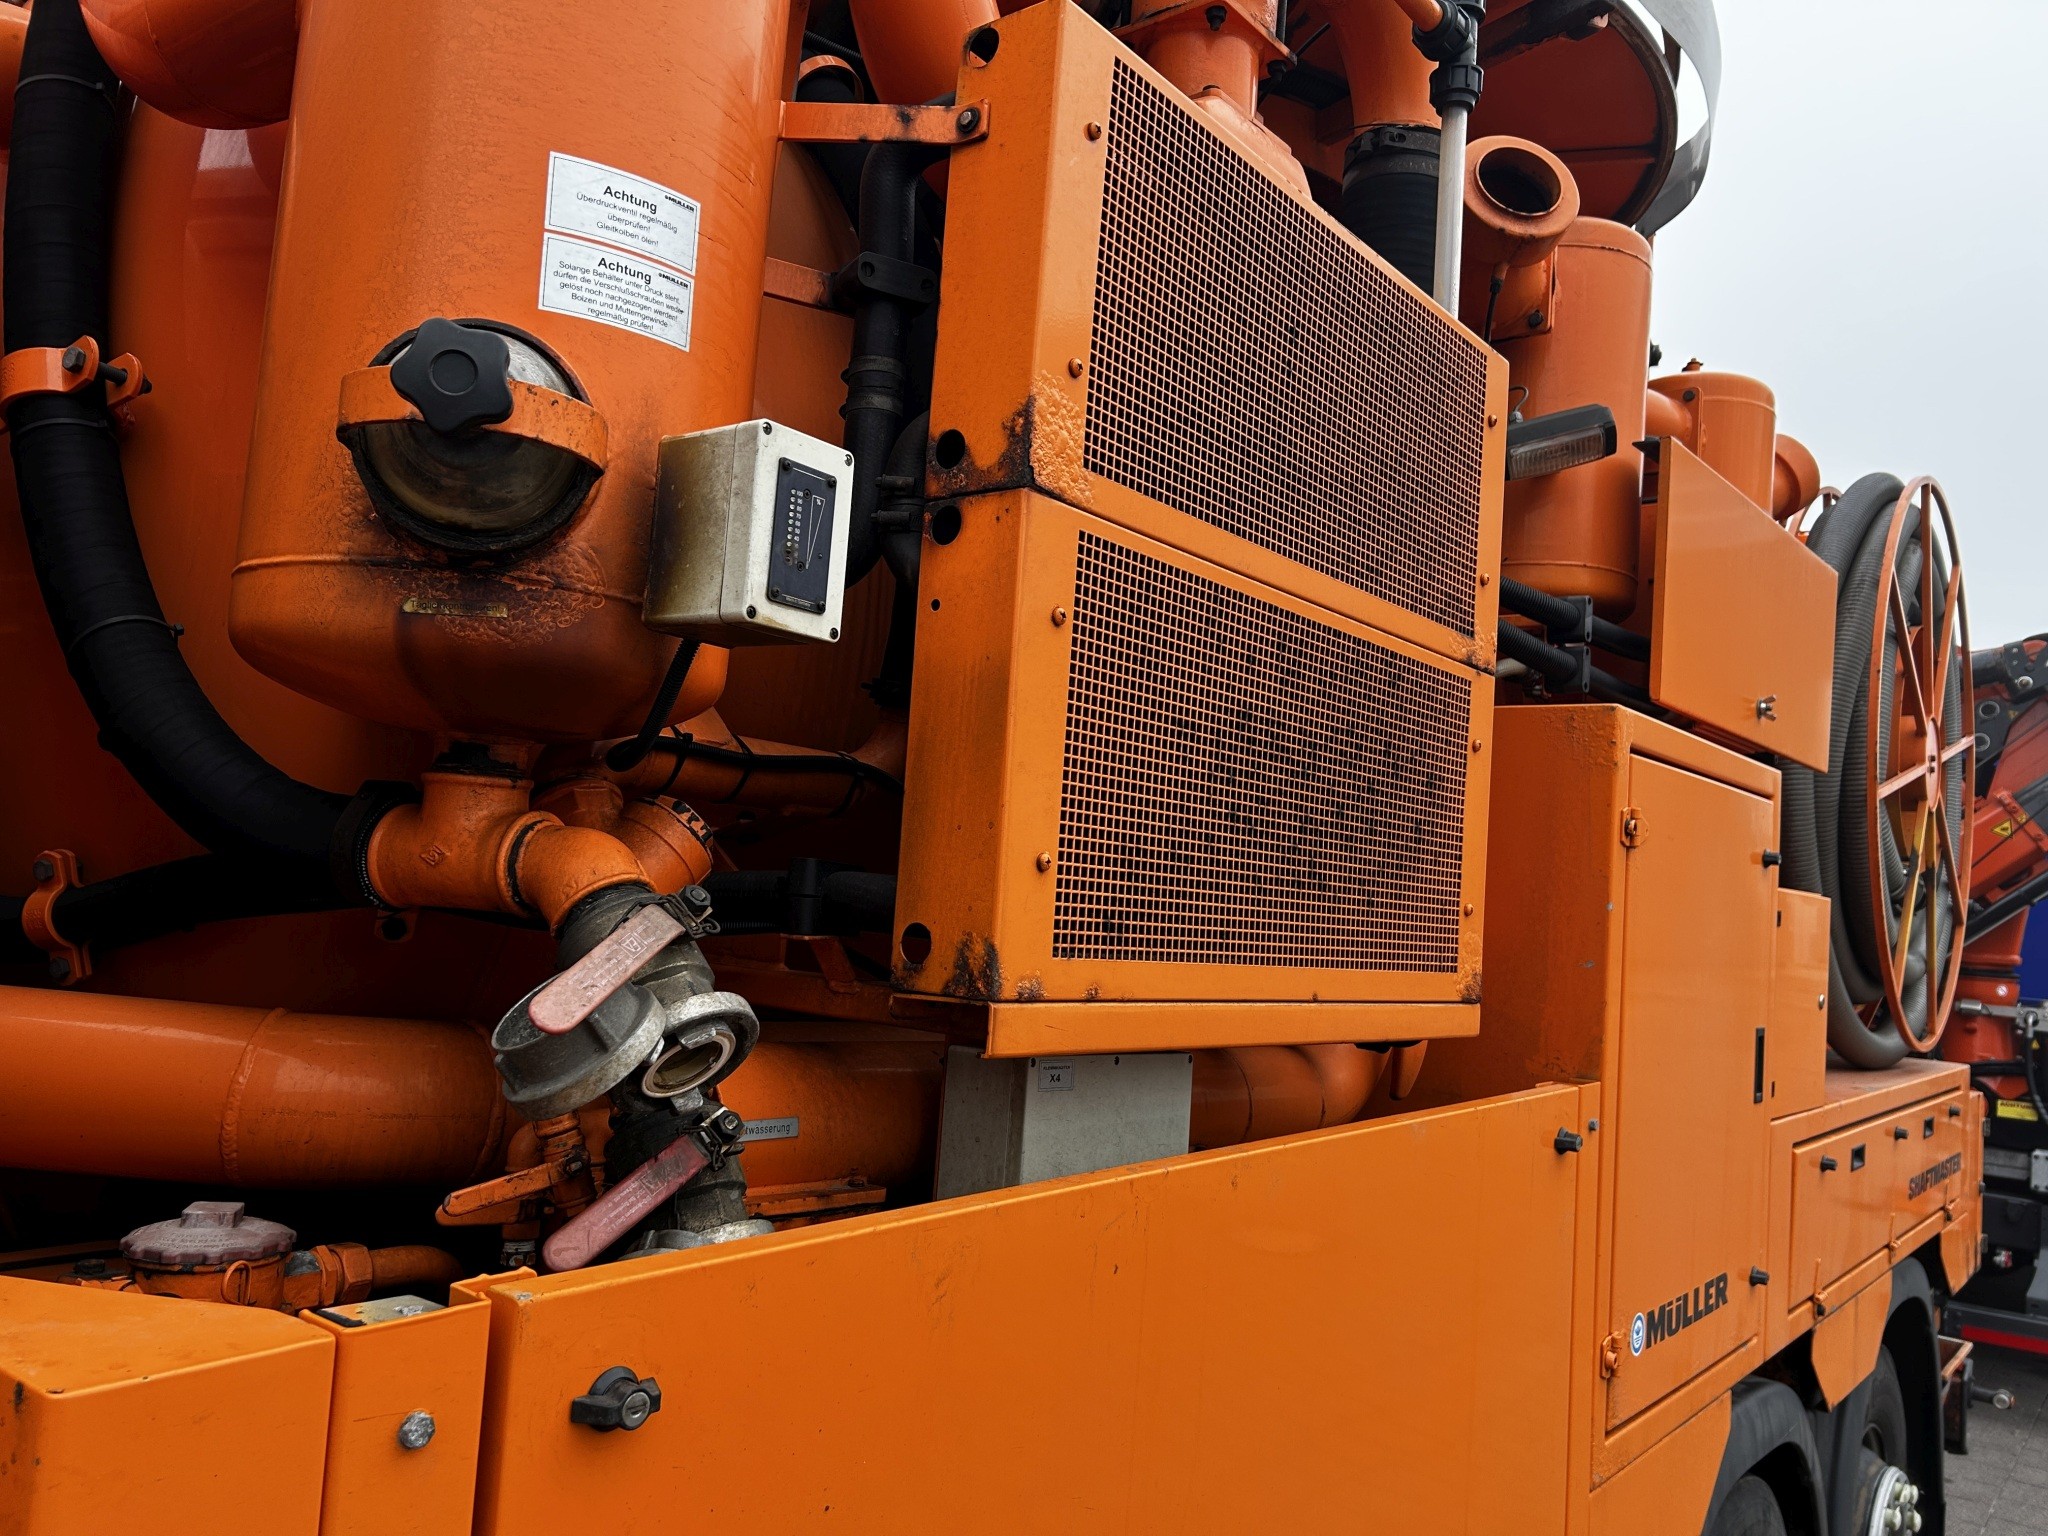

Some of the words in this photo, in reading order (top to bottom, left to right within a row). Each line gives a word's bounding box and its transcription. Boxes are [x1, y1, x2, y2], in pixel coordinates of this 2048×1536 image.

[576, 192, 638, 217] Überdruckventil
[639, 212, 678, 234] regelmäßig
[603, 185, 657, 215] Achtung
[596, 221, 639, 240] Gleitkolben
[607, 213, 651, 233] überprüfen!
[558, 261, 591, 274] Solange
[592, 269, 624, 283] Behälter
[624, 279, 643, 290] unter
[644, 285, 663, 297] Druck
[598, 257, 652, 285] Achtung
[553, 270, 578, 282] dürfen
[579, 275, 592, 285] die
[593, 279, 665, 307] Verschlußschrauben
[665, 302, 684, 315] weder
[559, 280, 583, 292] gelöst
[584, 287, 604, 297] noch
[605, 292, 652, 313] nachgezogen
[653, 307, 678, 322] werden!
[571, 293, 598, 305] Bolzen
[599, 300, 614, 310] und
[615, 304, 668, 328] Mutterngewinde
[587, 307, 628, 324] regelmäßig
[629, 318, 654, 331] prüfen!
[1049, 1073, 1061, 1083] X4
[745, 1123, 791, 1135] twässerung
[1646, 1272, 1728, 1350] MÜLLER
